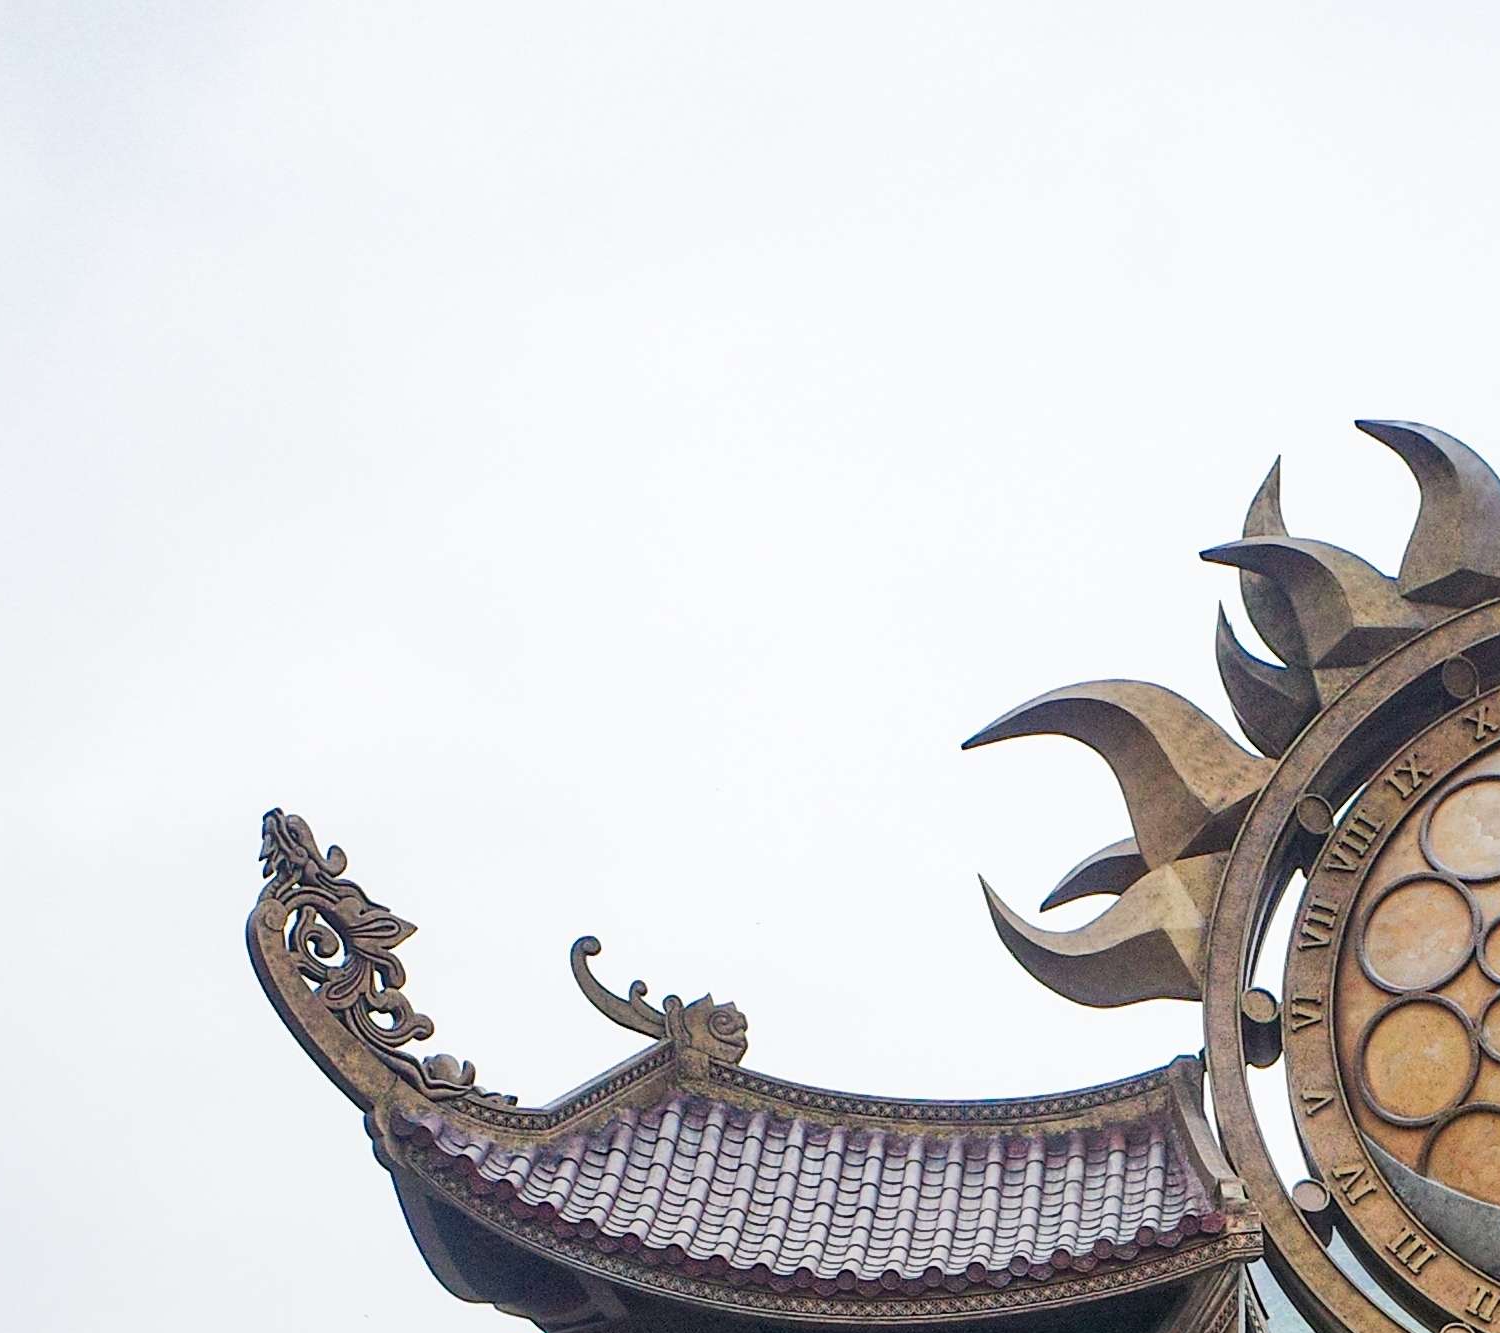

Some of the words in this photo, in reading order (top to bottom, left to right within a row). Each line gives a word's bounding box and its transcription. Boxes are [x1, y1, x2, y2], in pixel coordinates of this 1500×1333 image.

[1465, 706, 1498, 741] X
[1384, 753, 1433, 800] IX
[1324, 808, 1385, 873] VIII
[1298, 896, 1341, 951] VII
[1292, 992, 1322, 1032] VI
[1301, 1088, 1334, 1117] V
[1331, 1164, 1377, 1205] IV
[1386, 1227, 1438, 1275] III
